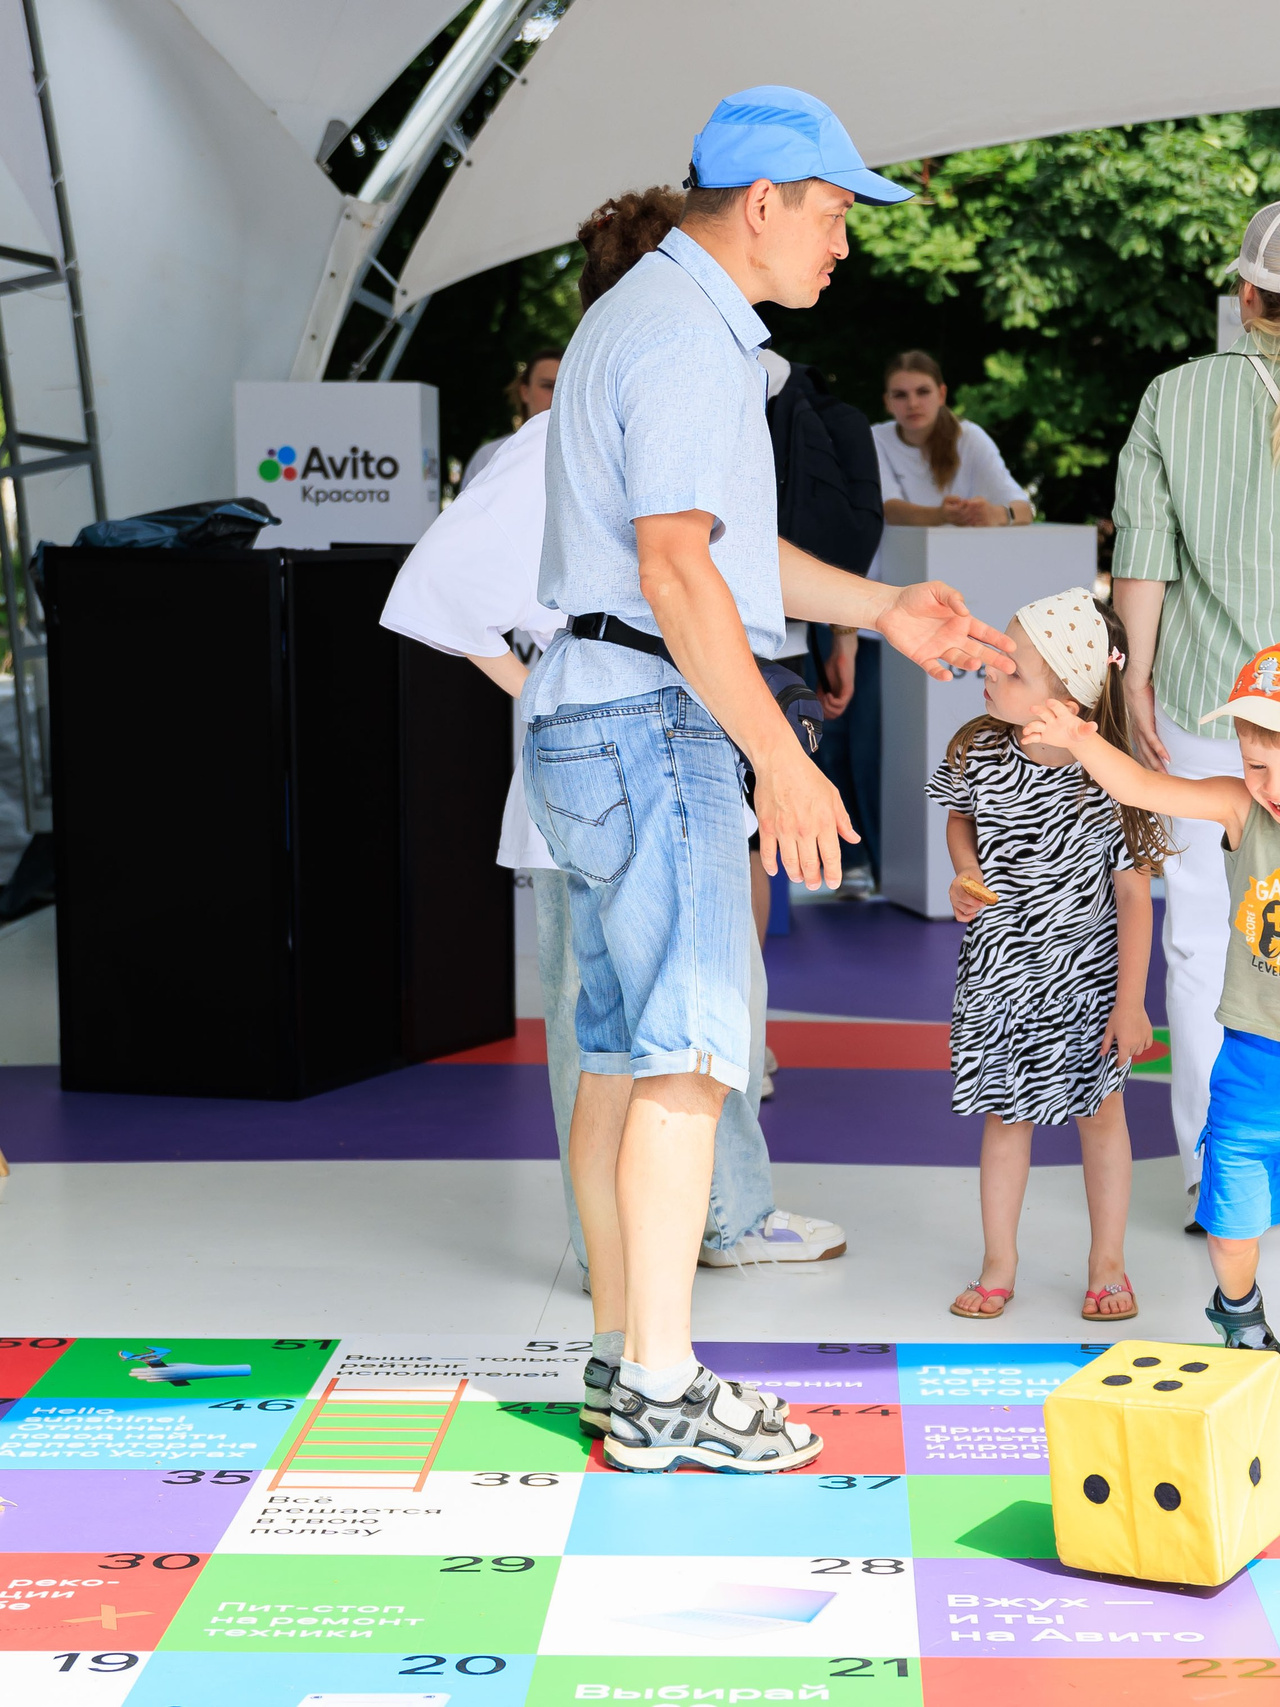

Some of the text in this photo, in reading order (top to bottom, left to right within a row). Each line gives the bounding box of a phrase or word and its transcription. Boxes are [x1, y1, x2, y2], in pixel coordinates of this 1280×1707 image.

[301, 446, 399, 480] Avito
[302, 485, 390, 507] Красота
[271, 1339, 343, 1350] 51
[523, 1341, 593, 1353] 52
[816, 1343, 891, 1354] 53
[1080, 1343, 1110, 1354] 5
[339, 1362, 467, 1370] рейтинг
[916, 1366, 1022, 1375] Лето
[918, 1378, 1061, 1387] хорош
[920, 1388, 1050, 1398] истор
[32, 1407, 116, 1415] Hello
[207, 1399, 296, 1412] 46
[496, 1402, 581, 1415] 45
[807, 1405, 898, 1415] 44
[24, 1415, 187, 1423] sunshine!
[16, 1423, 195, 1432] Отличный
[8, 1432, 228, 1441] повод найти
[924, 1434, 1047, 1443] фильтр
[0, 1442, 207, 1451] репетитора
[0, 1450, 248, 1460] Авито Услугах
[161, 1470, 253, 1485] 35
[470, 1472, 560, 1487] 36
[817, 1476, 902, 1490] 37
[267, 1495, 333, 1504] Всё
[250, 1528, 382, 1537] пользу
[98, 1553, 200, 1570] 30
[439, 1556, 535, 1572] 29
[810, 1558, 905, 1574] 28
[8, 1578, 120, 1588] реко-
[216, 1602, 405, 1613] Пит-стоп
[947, 1594, 1090, 1610] Вжух
[210, 1616, 425, 1627] на ремонт
[948, 1614, 1064, 1624] и ты
[203, 1628, 374, 1638] техники
[950, 1628, 1205, 1642] на Авито
[53, 1653, 139, 1672] 19
[397, 1655, 507, 1675] 20
[828, 1658, 910, 1677] 21
[574, 1684, 831, 1703] Выбирай
